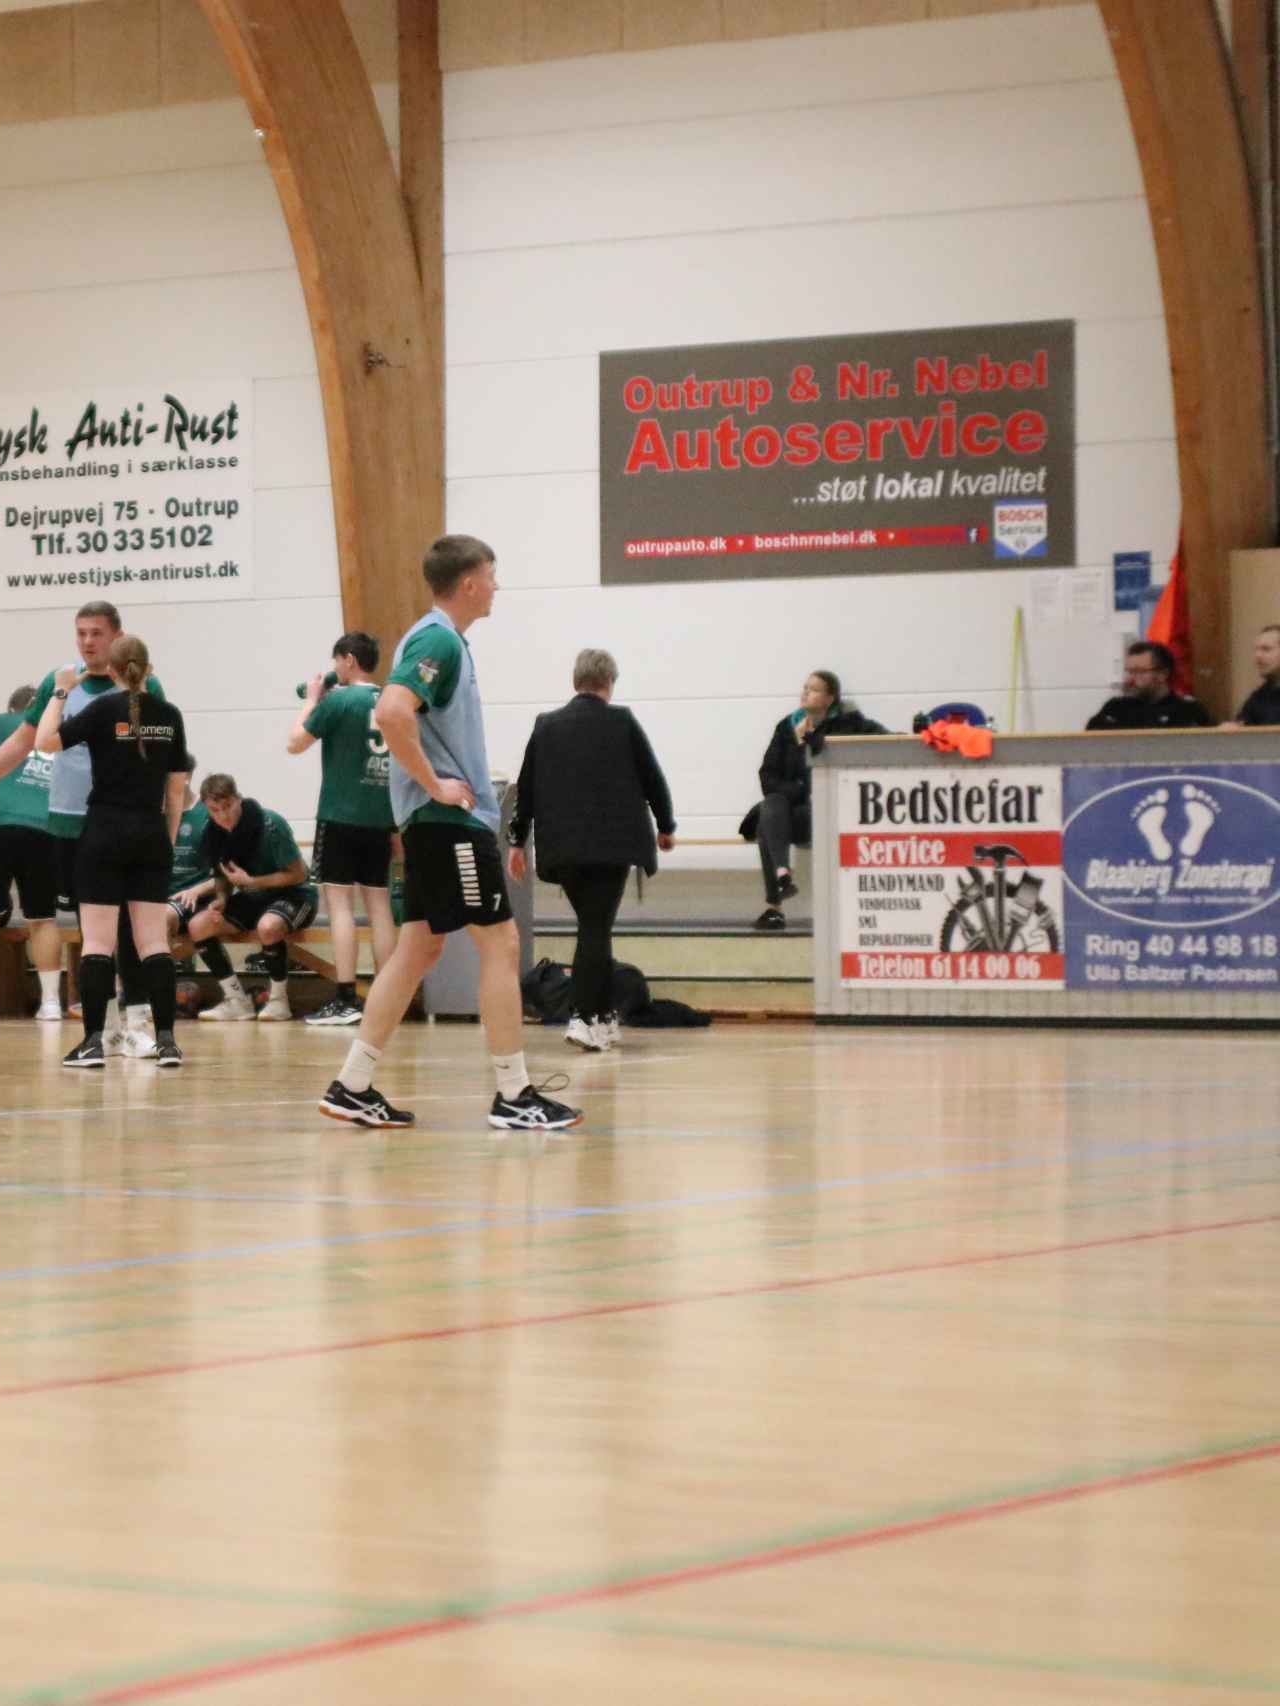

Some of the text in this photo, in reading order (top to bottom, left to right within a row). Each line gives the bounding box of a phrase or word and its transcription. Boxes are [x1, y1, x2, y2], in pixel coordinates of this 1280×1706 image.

[623, 350, 1048, 414] Outrup & Nr. Nebel
[64, 393, 238, 462] Anti-Rust
[624, 401, 1048, 475] Autoservice
[127, 459, 132, 474] i
[141, 454, 238, 473] særklasse
[874, 469, 943, 500] lokal
[949, 466, 1046, 497] kvalitet
[5, 496, 238, 529] Dejrupvej 75 Outrup
[998, 510, 1045, 523] BOSCH
[32, 532, 71, 556] Tlf.
[76, 531, 108, 553] 30
[113, 528, 145, 551] 33
[627, 536, 727, 557] outrupauto.dk
[754, 529, 877, 549] boschnrnebel.dk
[7, 560, 239, 588] www.vestjysk-antirust.dk
[858, 779, 1043, 825] Bedstefar
[857, 836, 945, 865] Service
[858, 874, 944, 892] HANDYMAND
[493, 893, 502, 911] 7
[1085, 934, 1141, 962] Ring
[1145, 934, 1174, 956] 40
[1179, 934, 1209, 956] 44
[857, 954, 925, 978] Telefon
[930, 954, 952, 978] 61
[958, 954, 980, 978] 14
[1190, 964, 1279, 982] Pedersen
